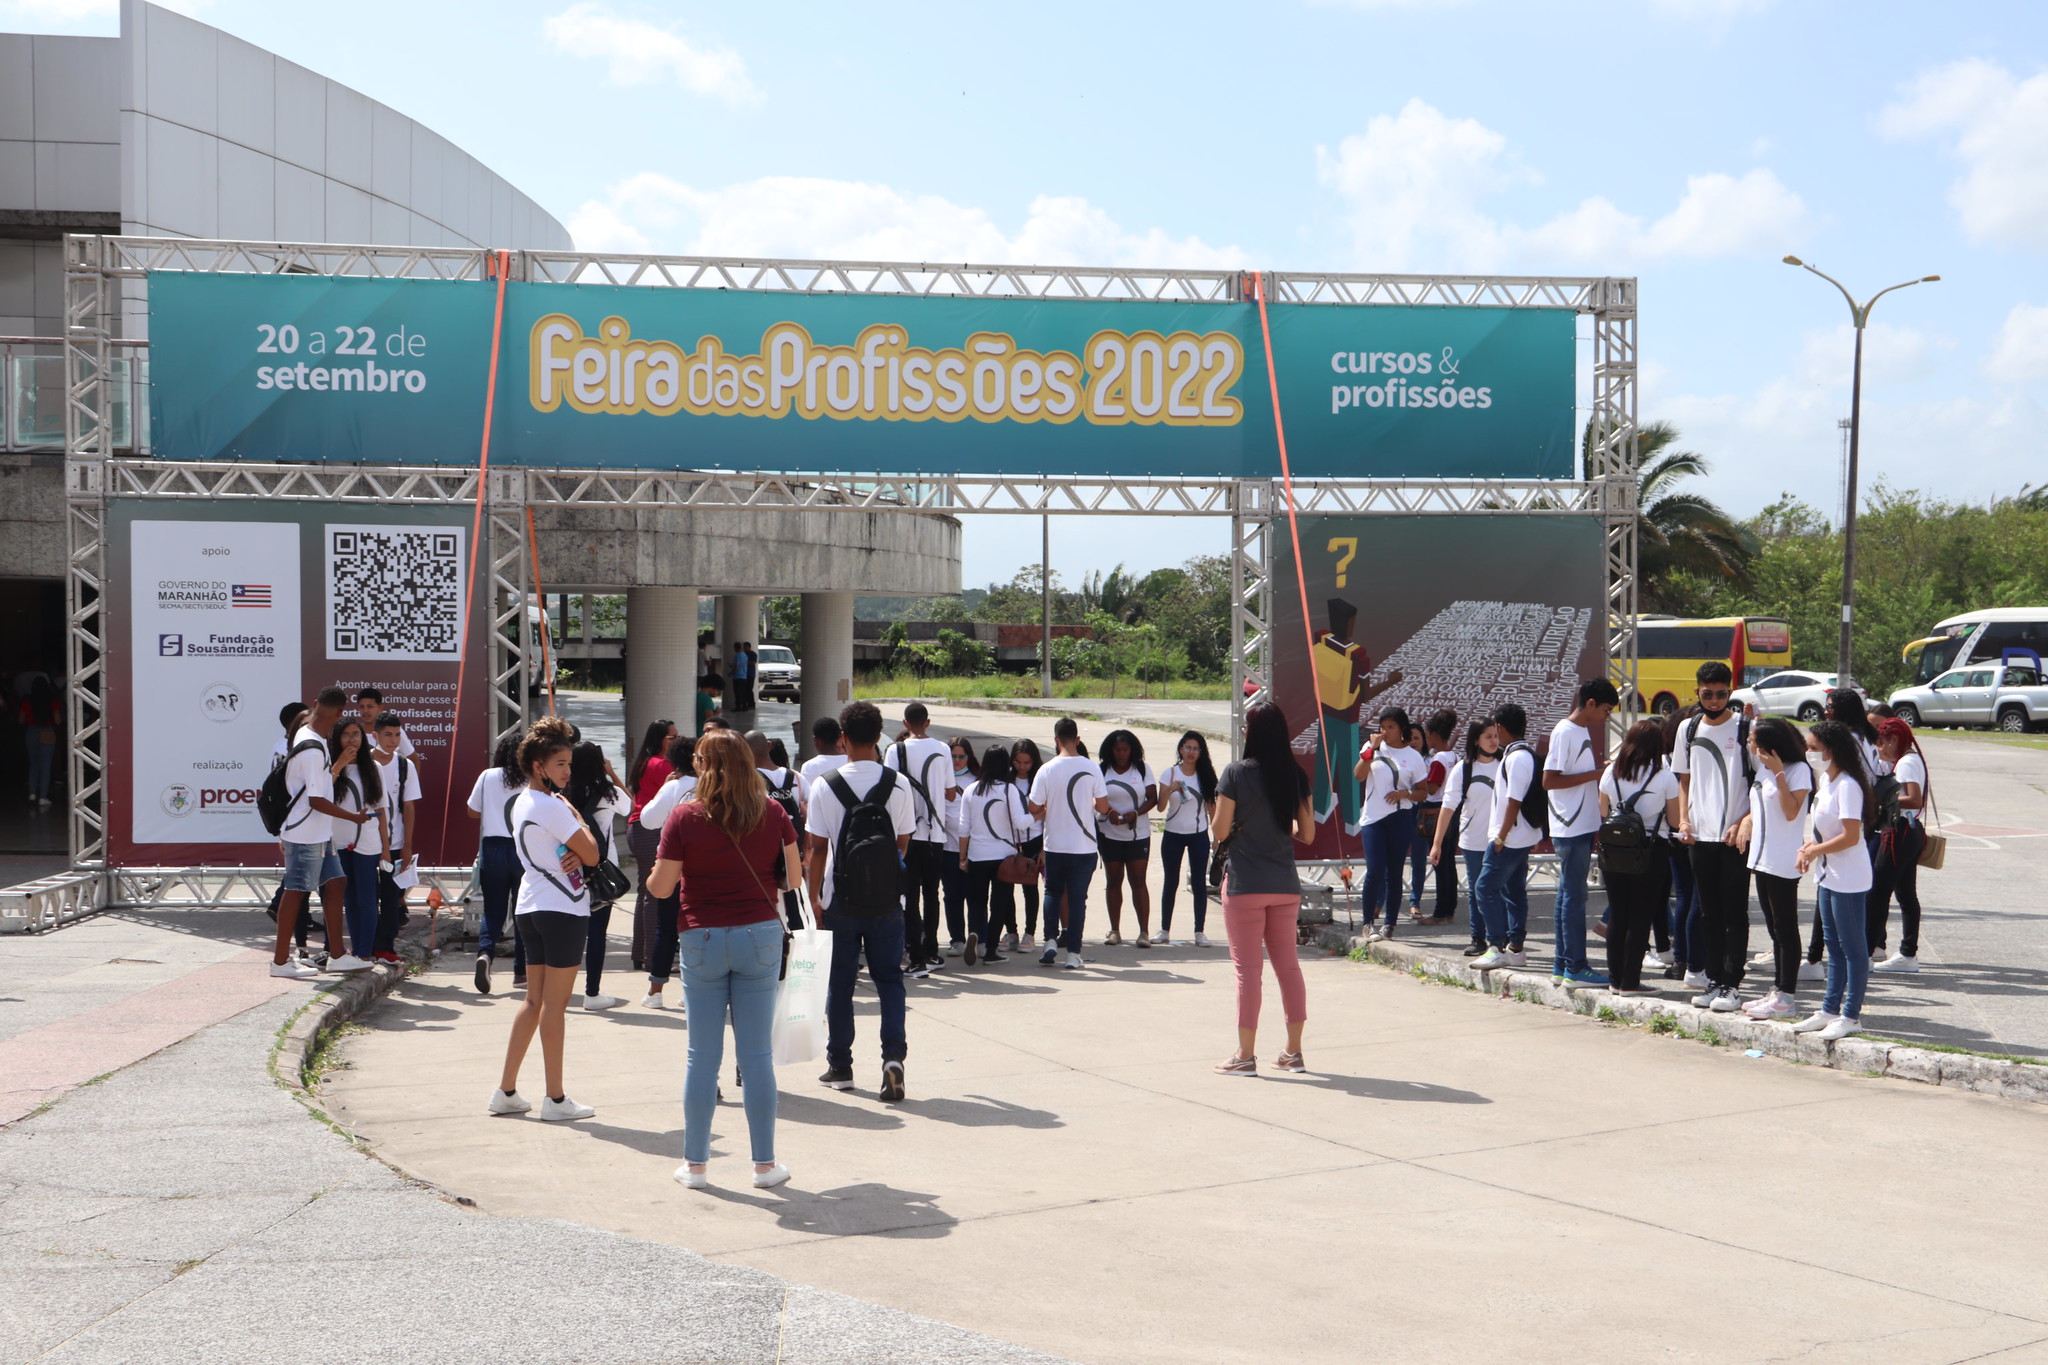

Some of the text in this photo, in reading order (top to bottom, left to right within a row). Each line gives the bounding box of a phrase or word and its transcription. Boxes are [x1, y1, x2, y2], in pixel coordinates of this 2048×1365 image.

[257, 324, 426, 357] 20 a 22 de
[1331, 346, 1460, 375] cursos &
[540, 323, 1236, 417] Feira das Profissões 2022
[256, 360, 427, 393] setembro
[1331, 378, 1492, 414] profissões
[202, 547, 231, 557] apoio
[158, 580, 227, 590] GOVERNO DO
[158, 590, 228, 601] MARANHÃO
[209, 634, 274, 646] Fundação
[187, 643, 274, 654] Sousândrade
[1421, 667, 1481, 676] DESIGN
[1404, 674, 1476, 684] DAGOGIA
[335, 680, 370, 690] Aponte
[372, 682, 389, 690] seu
[391, 680, 424, 690] celular
[427, 682, 449, 691] para
[1389, 682, 1482, 693] SICOLOGIA
[410, 696, 416, 704] e
[418, 696, 450, 704] acesse
[390, 709, 443, 718] Profissões
[404, 722, 442, 732] Federal
[424, 737, 447, 746] mais
[192, 760, 243, 771] realização
